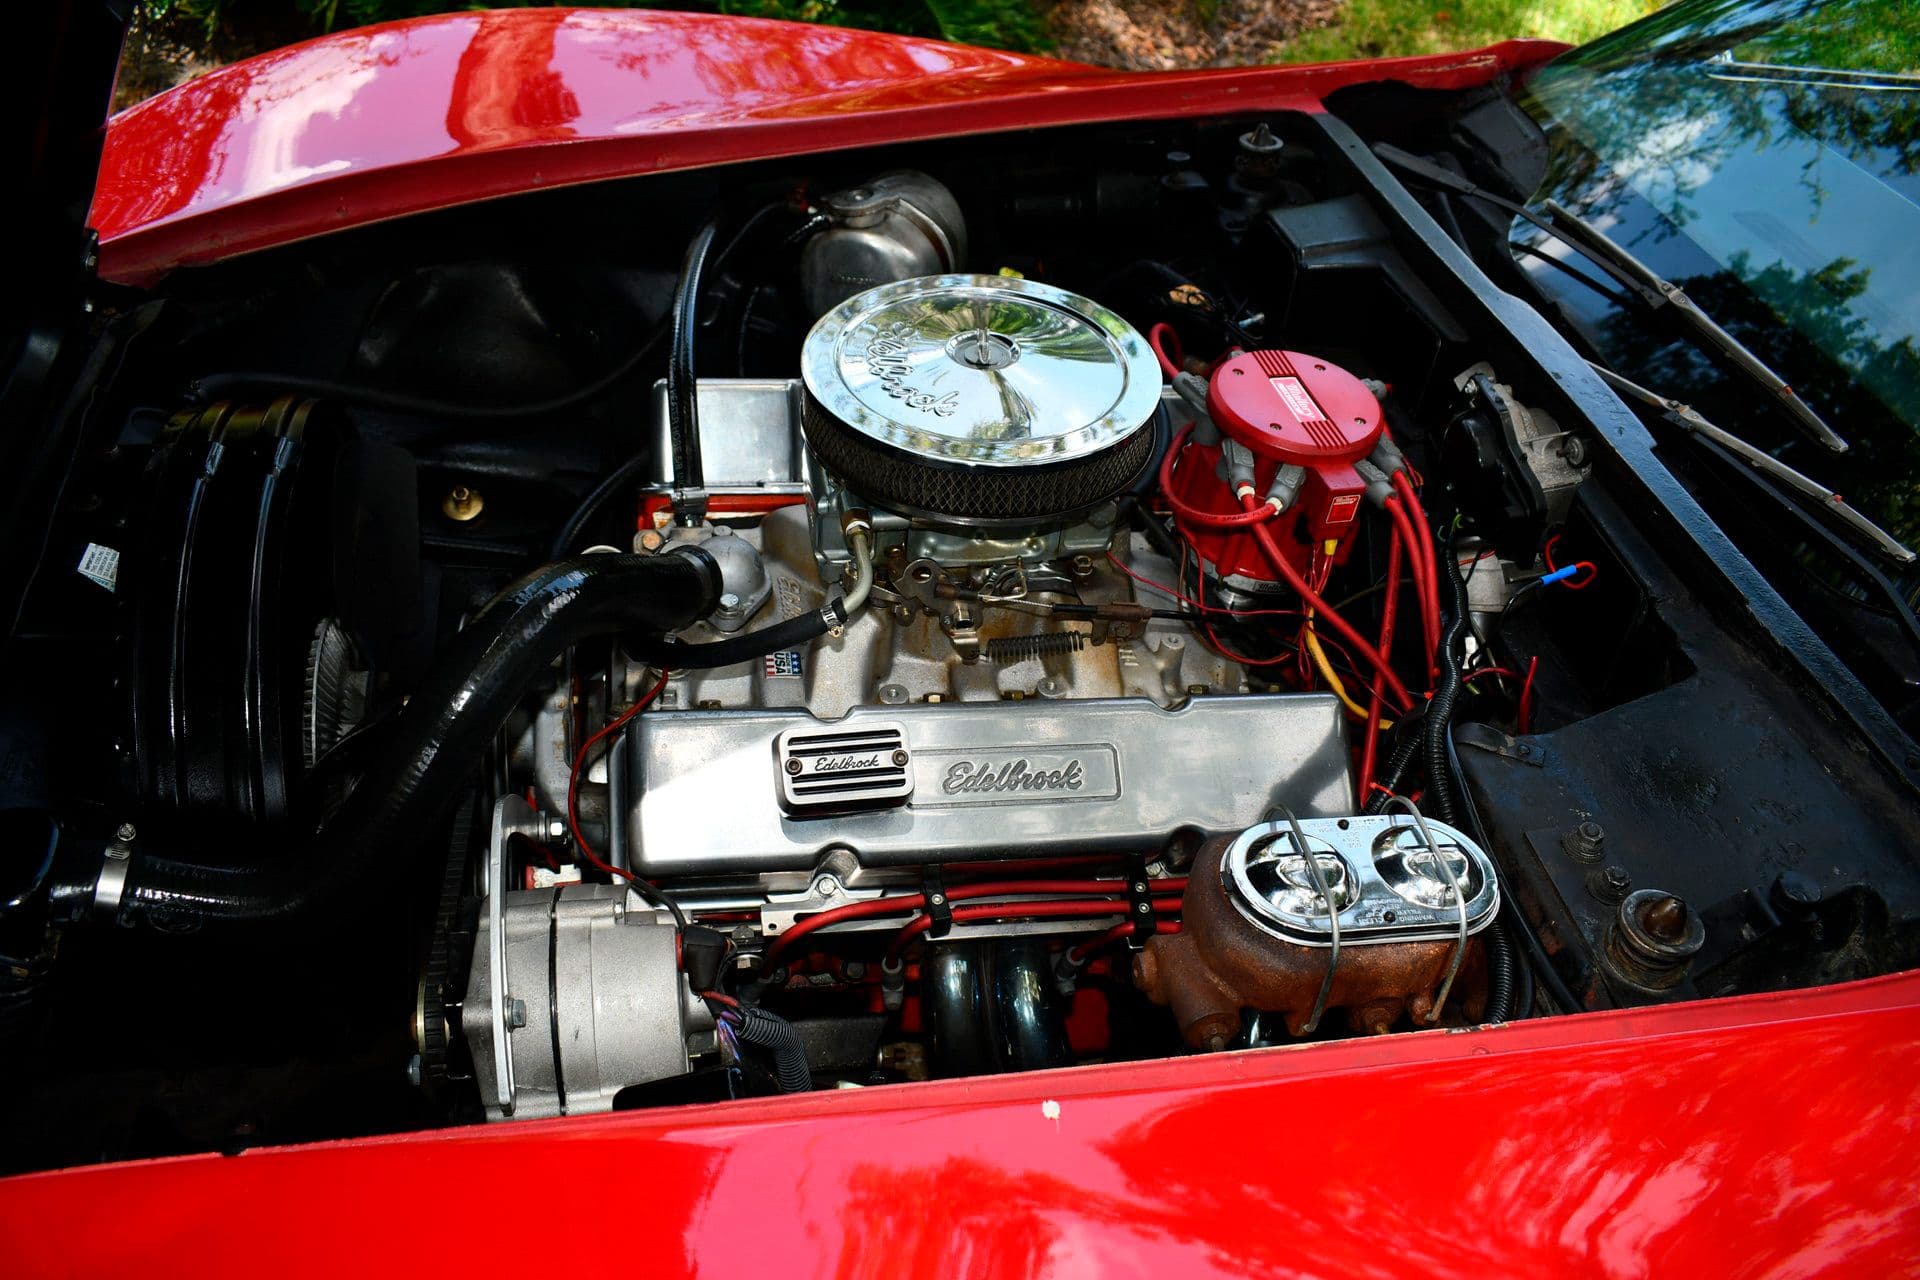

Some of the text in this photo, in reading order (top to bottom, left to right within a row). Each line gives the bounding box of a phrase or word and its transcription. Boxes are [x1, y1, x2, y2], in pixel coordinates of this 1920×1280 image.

[866, 321, 960, 418] Edelbrock
[774, 652, 786, 674] USA
[814, 754, 880, 772] Edelbrock
[942, 760, 1083, 796] Edelbrock
